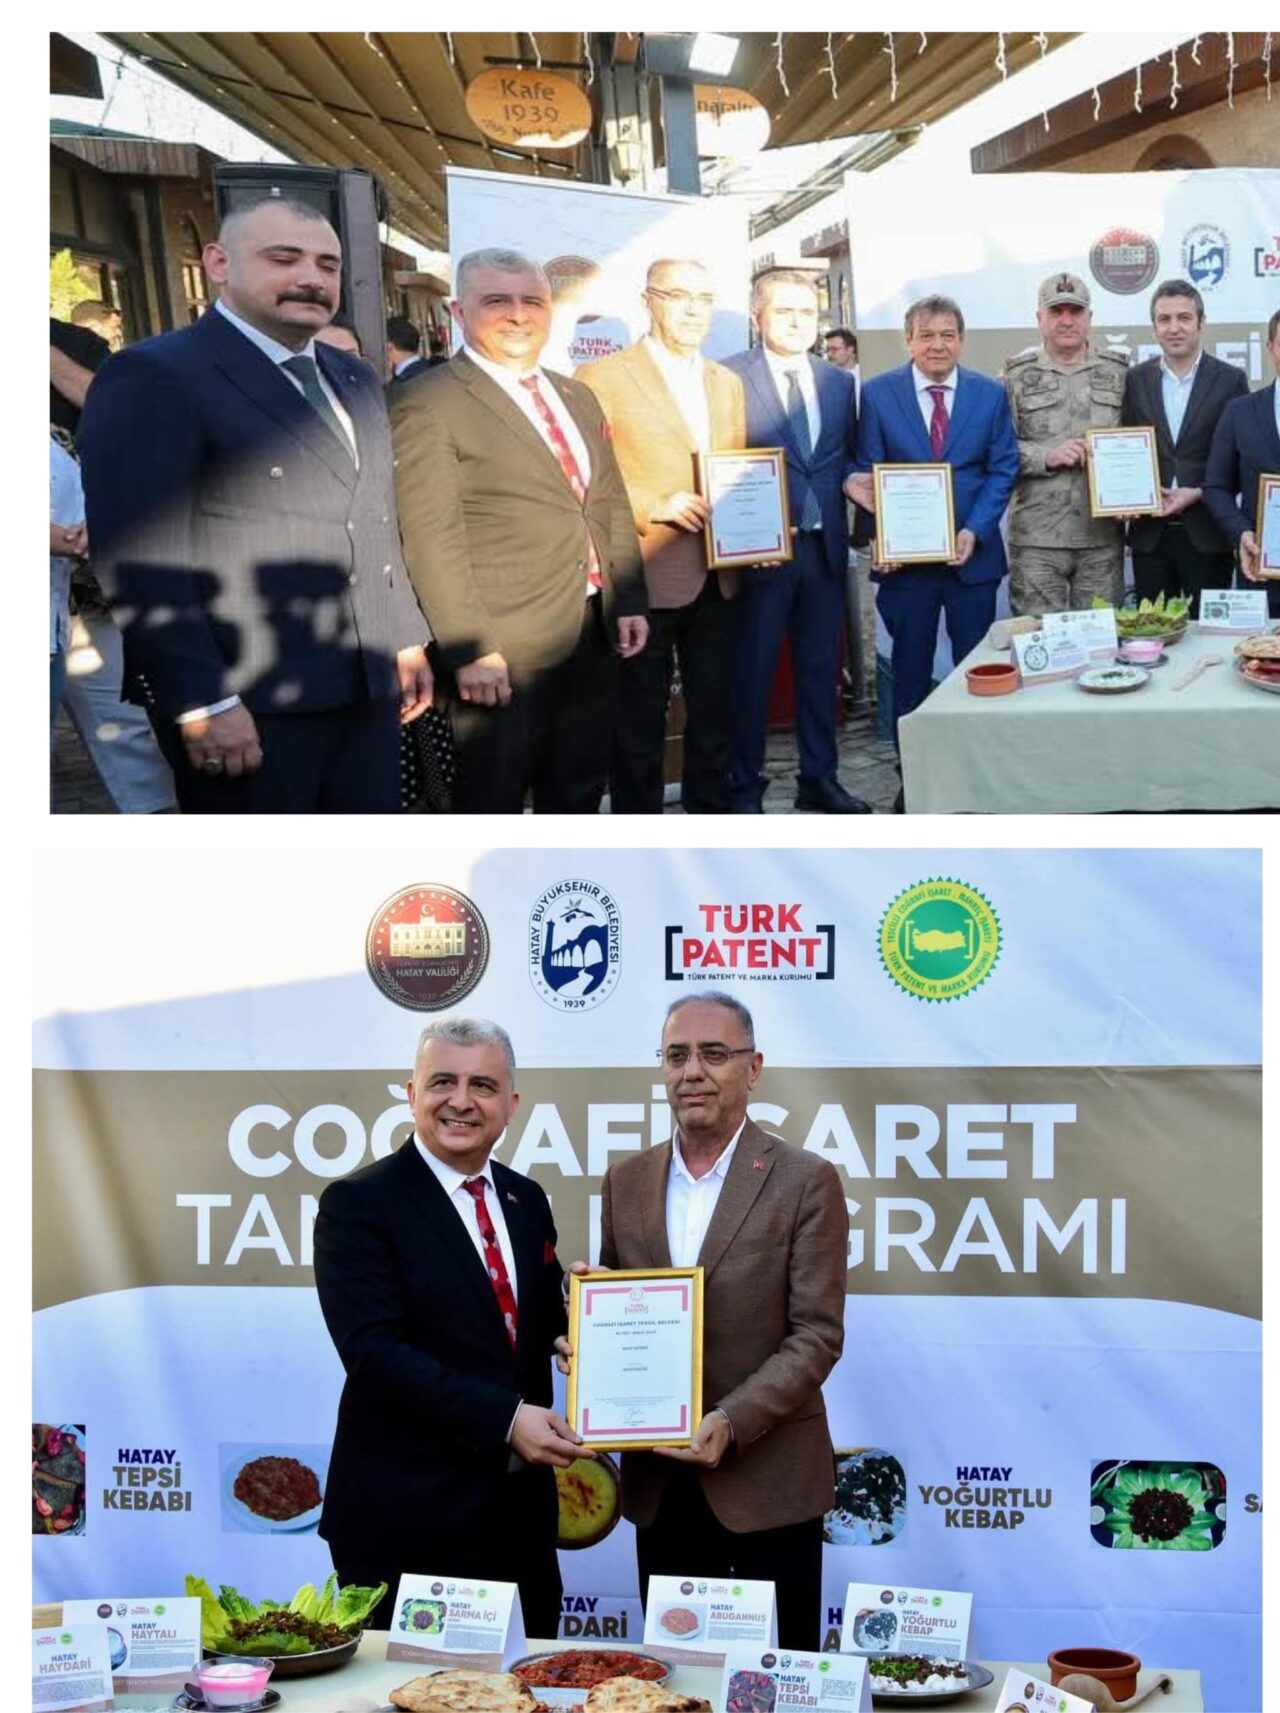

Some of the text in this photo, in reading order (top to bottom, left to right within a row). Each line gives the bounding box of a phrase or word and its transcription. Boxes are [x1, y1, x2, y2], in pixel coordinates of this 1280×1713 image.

[501, 79, 555, 101] Kafe
[504, 104, 559, 123] 1939
[699, 904, 803, 933] TÜRK
[531, 926, 541, 965] HATAY
[682, 938, 822, 968] PATENT
[708, 973, 735, 981] PATENT
[737, 973, 748, 981] VE
[750, 973, 777, 981] MARKA
[779, 973, 812, 981] KURUMU
[563, 1000, 586, 1008] 1939
[118, 1448, 176, 1464] HATAY
[112, 1461, 181, 1488] TEPSİ
[956, 1466, 1013, 1481] HATAY
[103, 1489, 192, 1511] KEBABI
[918, 1481, 1052, 1509] YOĞURTLU
[944, 1509, 1025, 1530] KEBAP
[561, 1596, 598, 1612] TAY
[448, 1608, 480, 1620] SARMA
[902, 1612, 957, 1628] YOĞURTLU
[560, 1610, 627, 1638] DARİ
[901, 1625, 933, 1635] KEBAP
[131, 1629, 176, 1639] HAYTALI
[39, 1656, 91, 1674] HAYDARİ
[51, 1653, 77, 1662] HATAY
[780, 1674, 806, 1683] HATAY
[780, 1681, 810, 1694] TEPSİ
[778, 1693, 818, 1706] KEBABI
